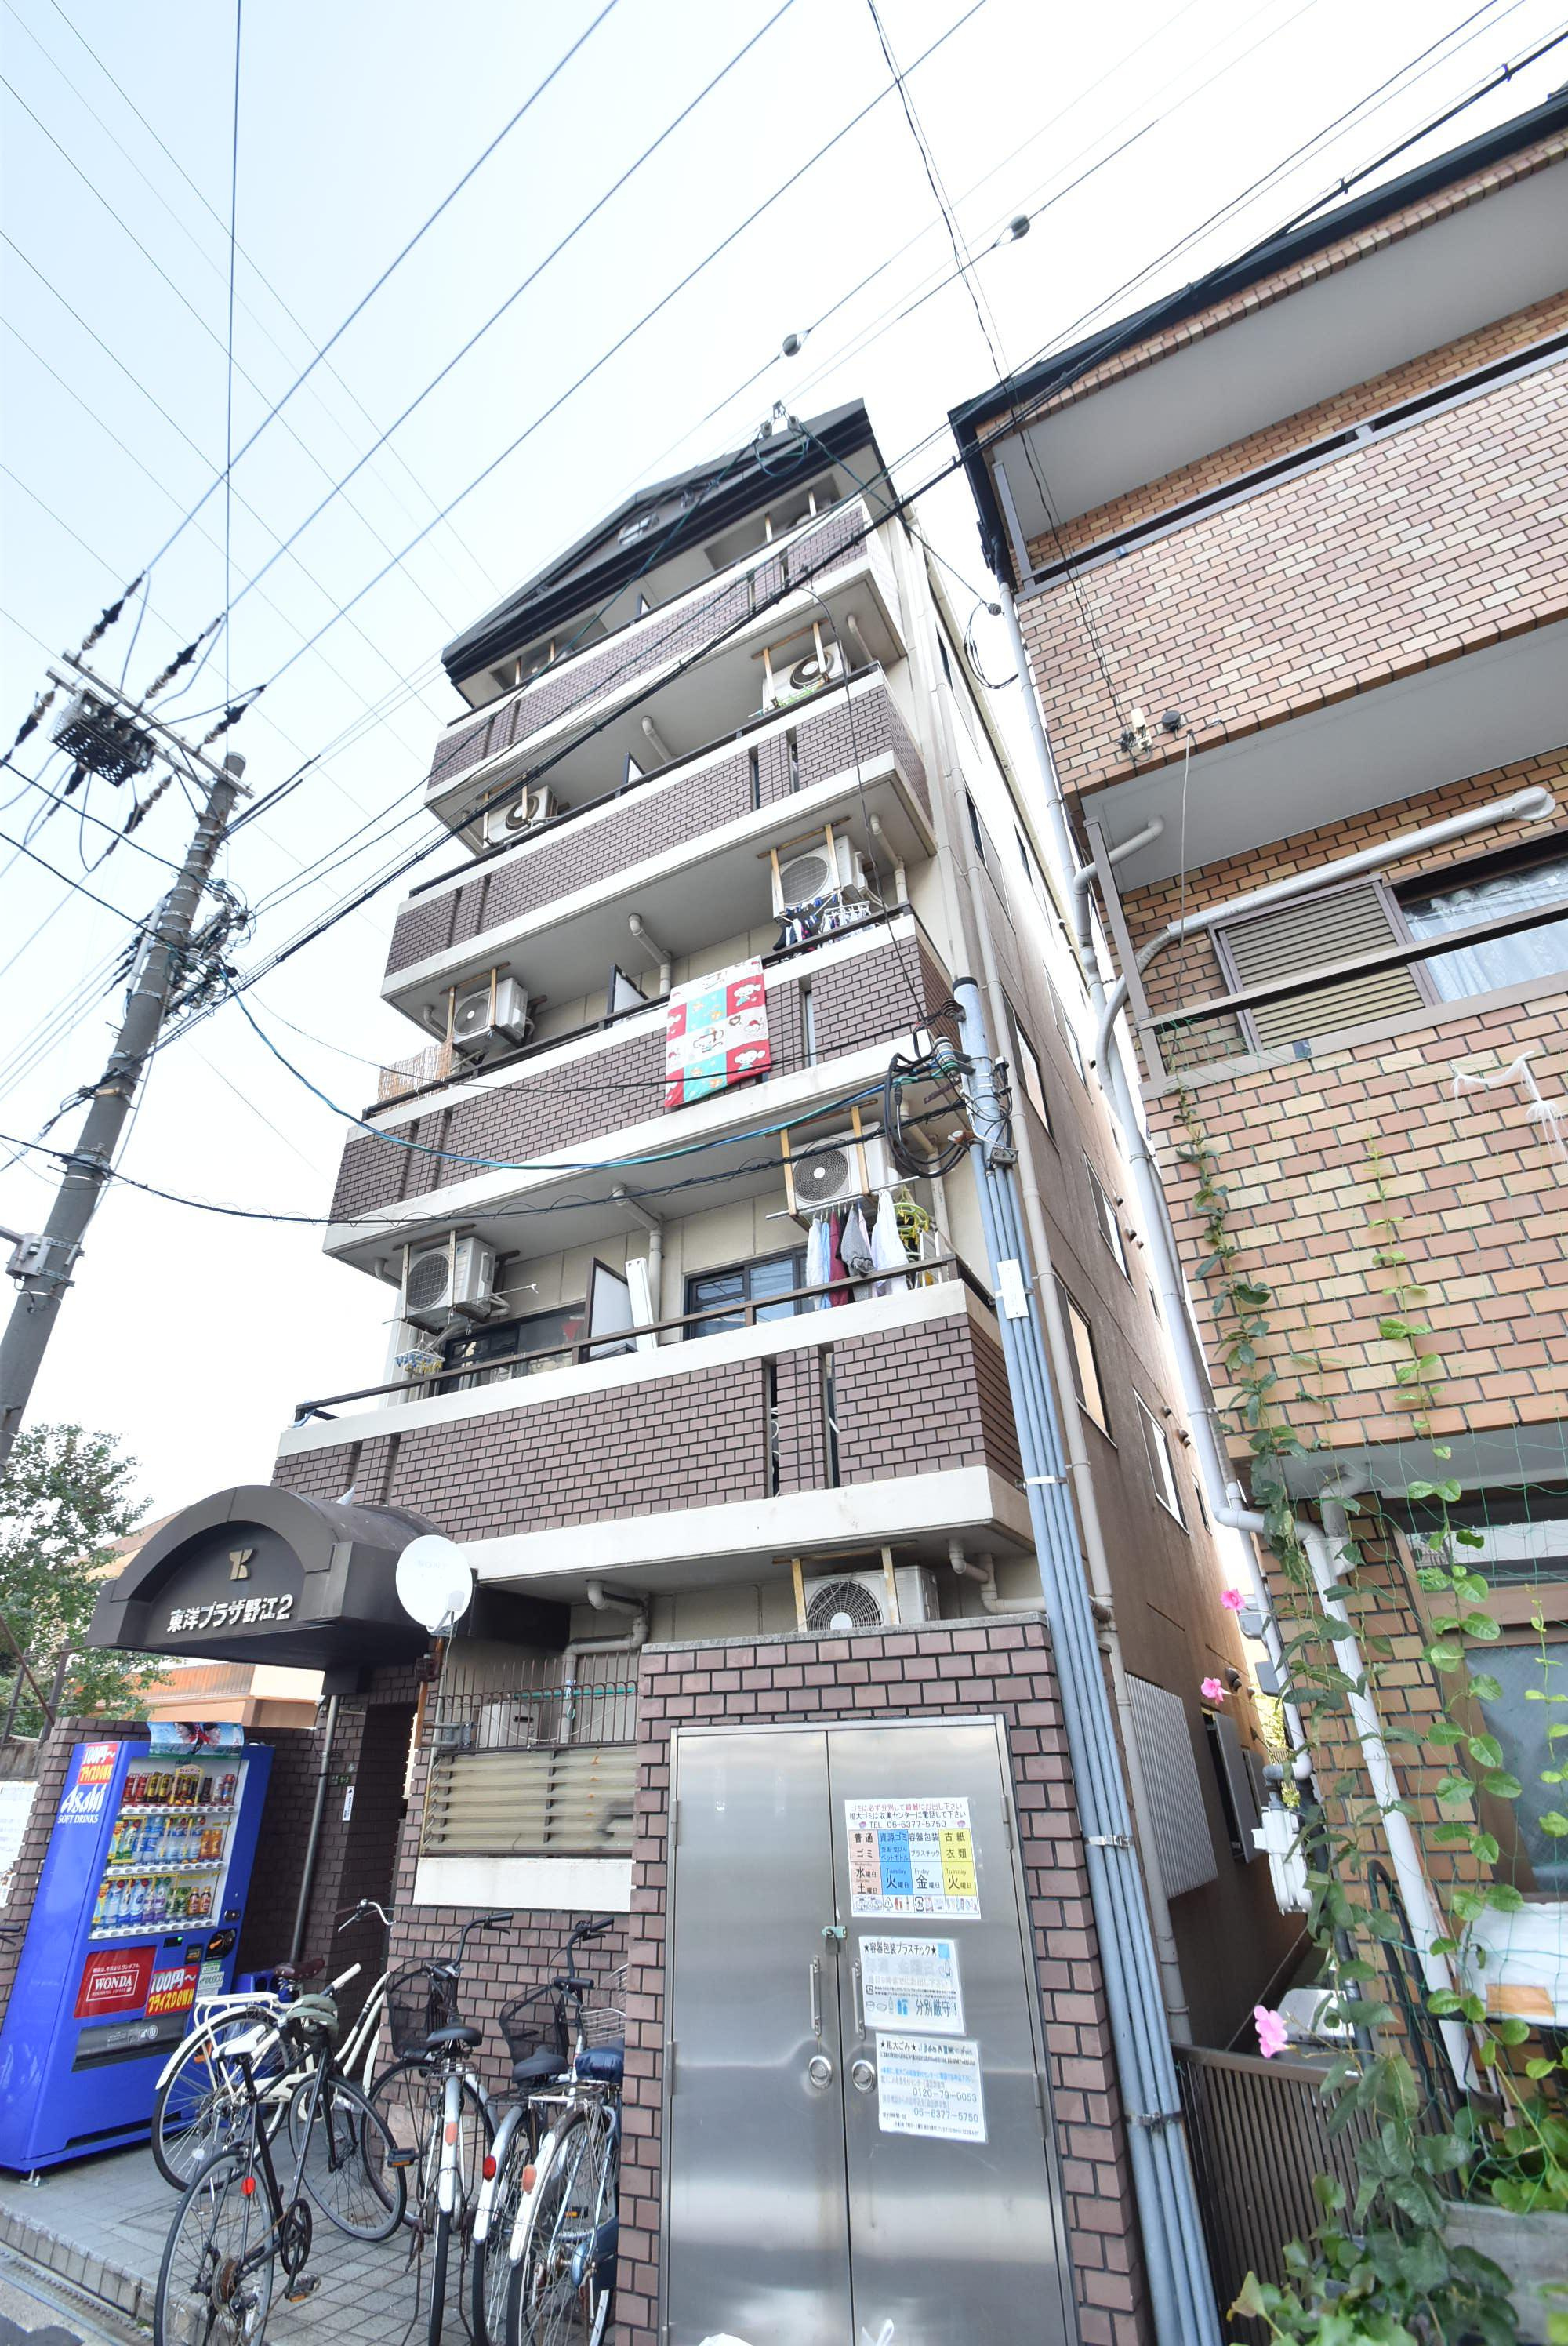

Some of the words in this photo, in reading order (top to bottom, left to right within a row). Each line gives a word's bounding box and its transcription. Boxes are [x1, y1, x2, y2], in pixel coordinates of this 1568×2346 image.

[167, 1593, 294, 1632] 東洋プラザ野江2
[60, 1783, 107, 1814] Asahi
[57, 1815, 74, 1824] SOFT
[75, 1814, 99, 1823] DRINKS
[887, 1820, 946, 1828] 06-6377-5750
[880, 1832, 908, 1842] 資源ゴミ
[909, 1832, 939, 1842] 容器包装
[910, 1849, 940, 1858] プラスチック
[95, 1974, 132, 1991] WONDA
[913, 2087, 978, 2103] 0120-79-0053
[913, 2107, 978, 2123] 06-6377-5750
